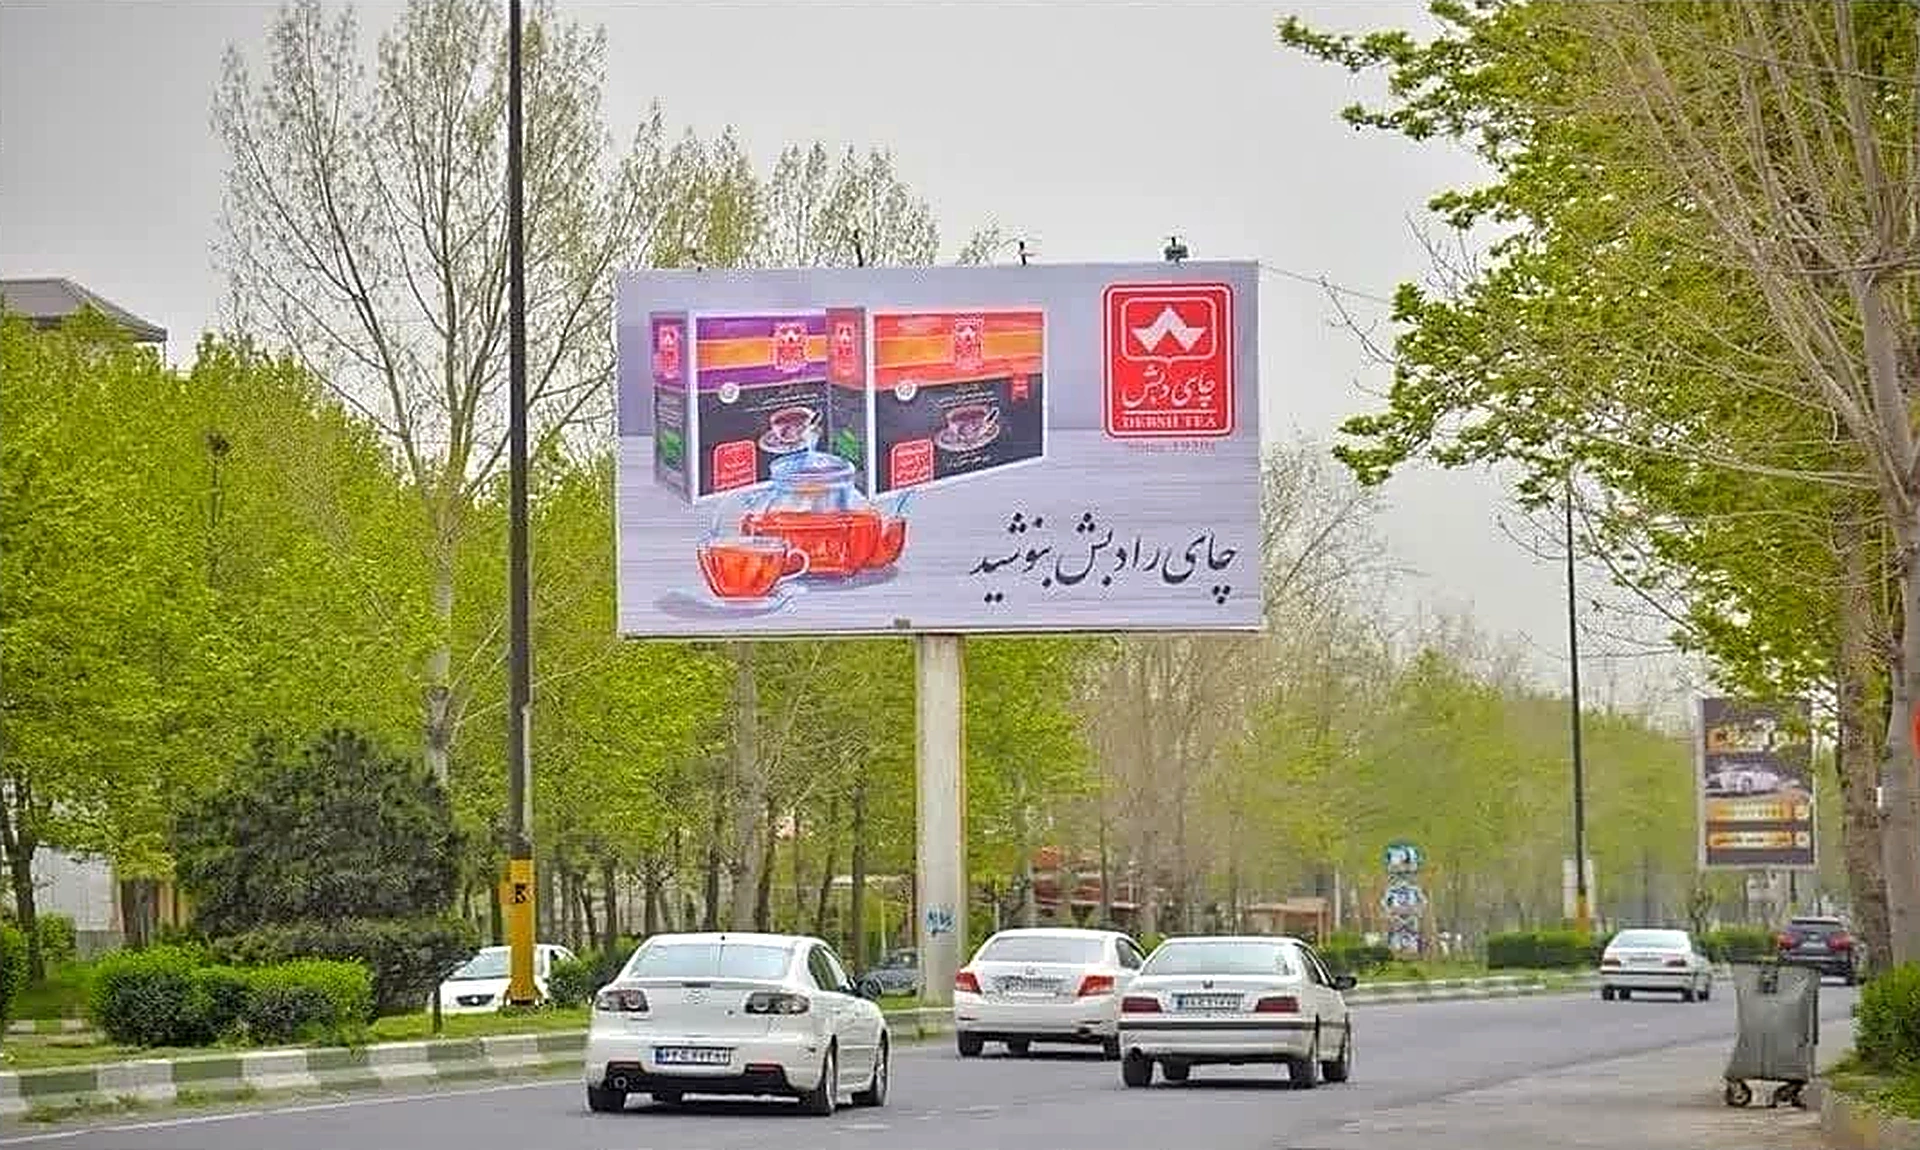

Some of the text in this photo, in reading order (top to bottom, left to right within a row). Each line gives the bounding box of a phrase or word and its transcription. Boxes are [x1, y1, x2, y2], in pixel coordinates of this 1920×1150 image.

[1121, 364, 1216, 408] چای دبش
[969, 512, 1237, 604] چای را دبش بنوشید
